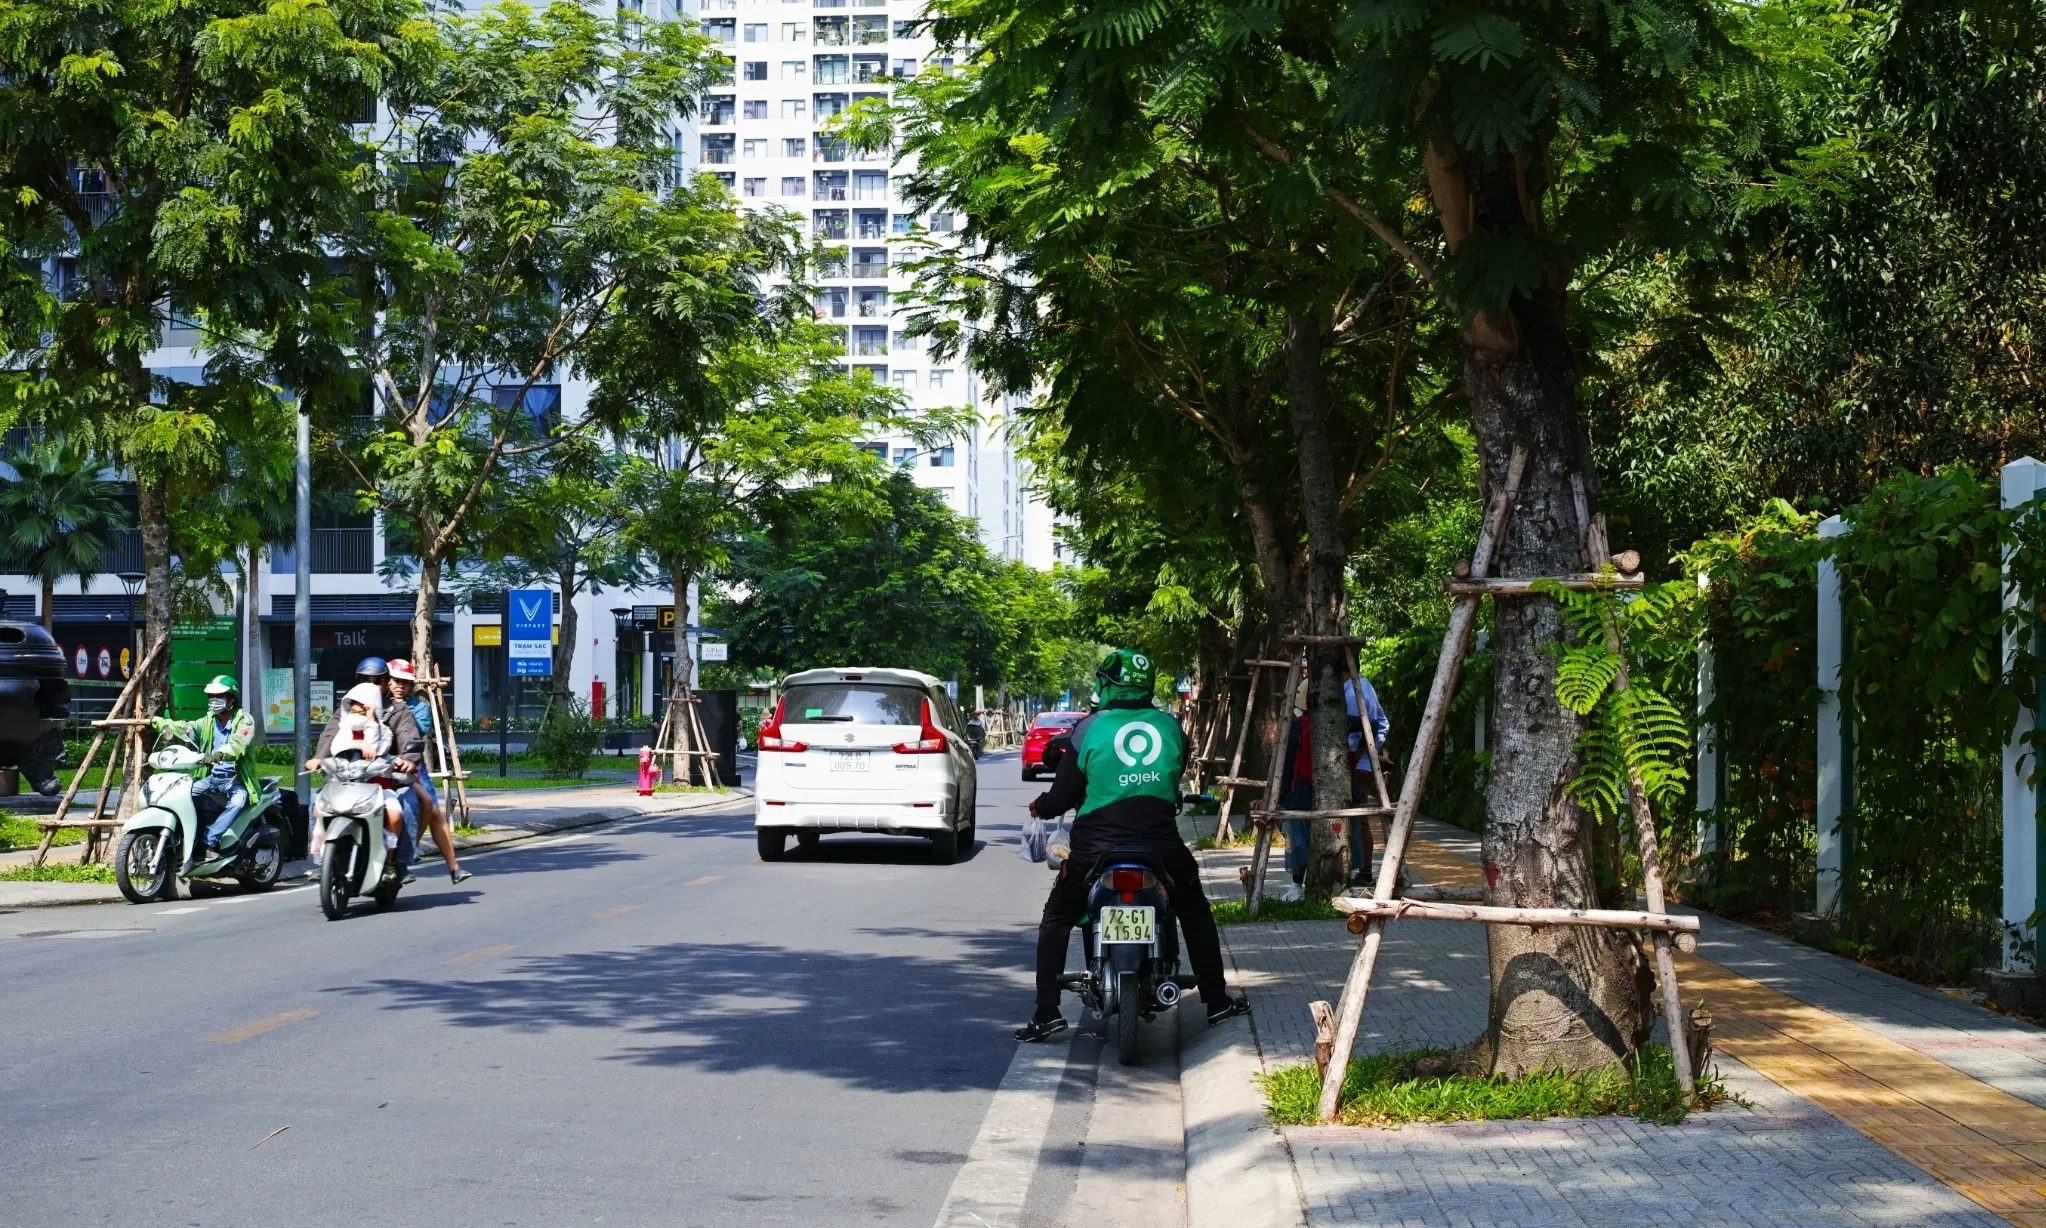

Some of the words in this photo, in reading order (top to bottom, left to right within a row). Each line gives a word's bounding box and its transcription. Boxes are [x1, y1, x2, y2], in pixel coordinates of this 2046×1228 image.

[664, 612, 675, 626] P
[334, 630, 366, 645] Talk
[1132, 671, 1148, 679] gojek
[1118, 770, 1160, 786] gojek
[1109, 909, 1145, 924] 72-G1
[1103, 926, 1151, 940] 415.94
